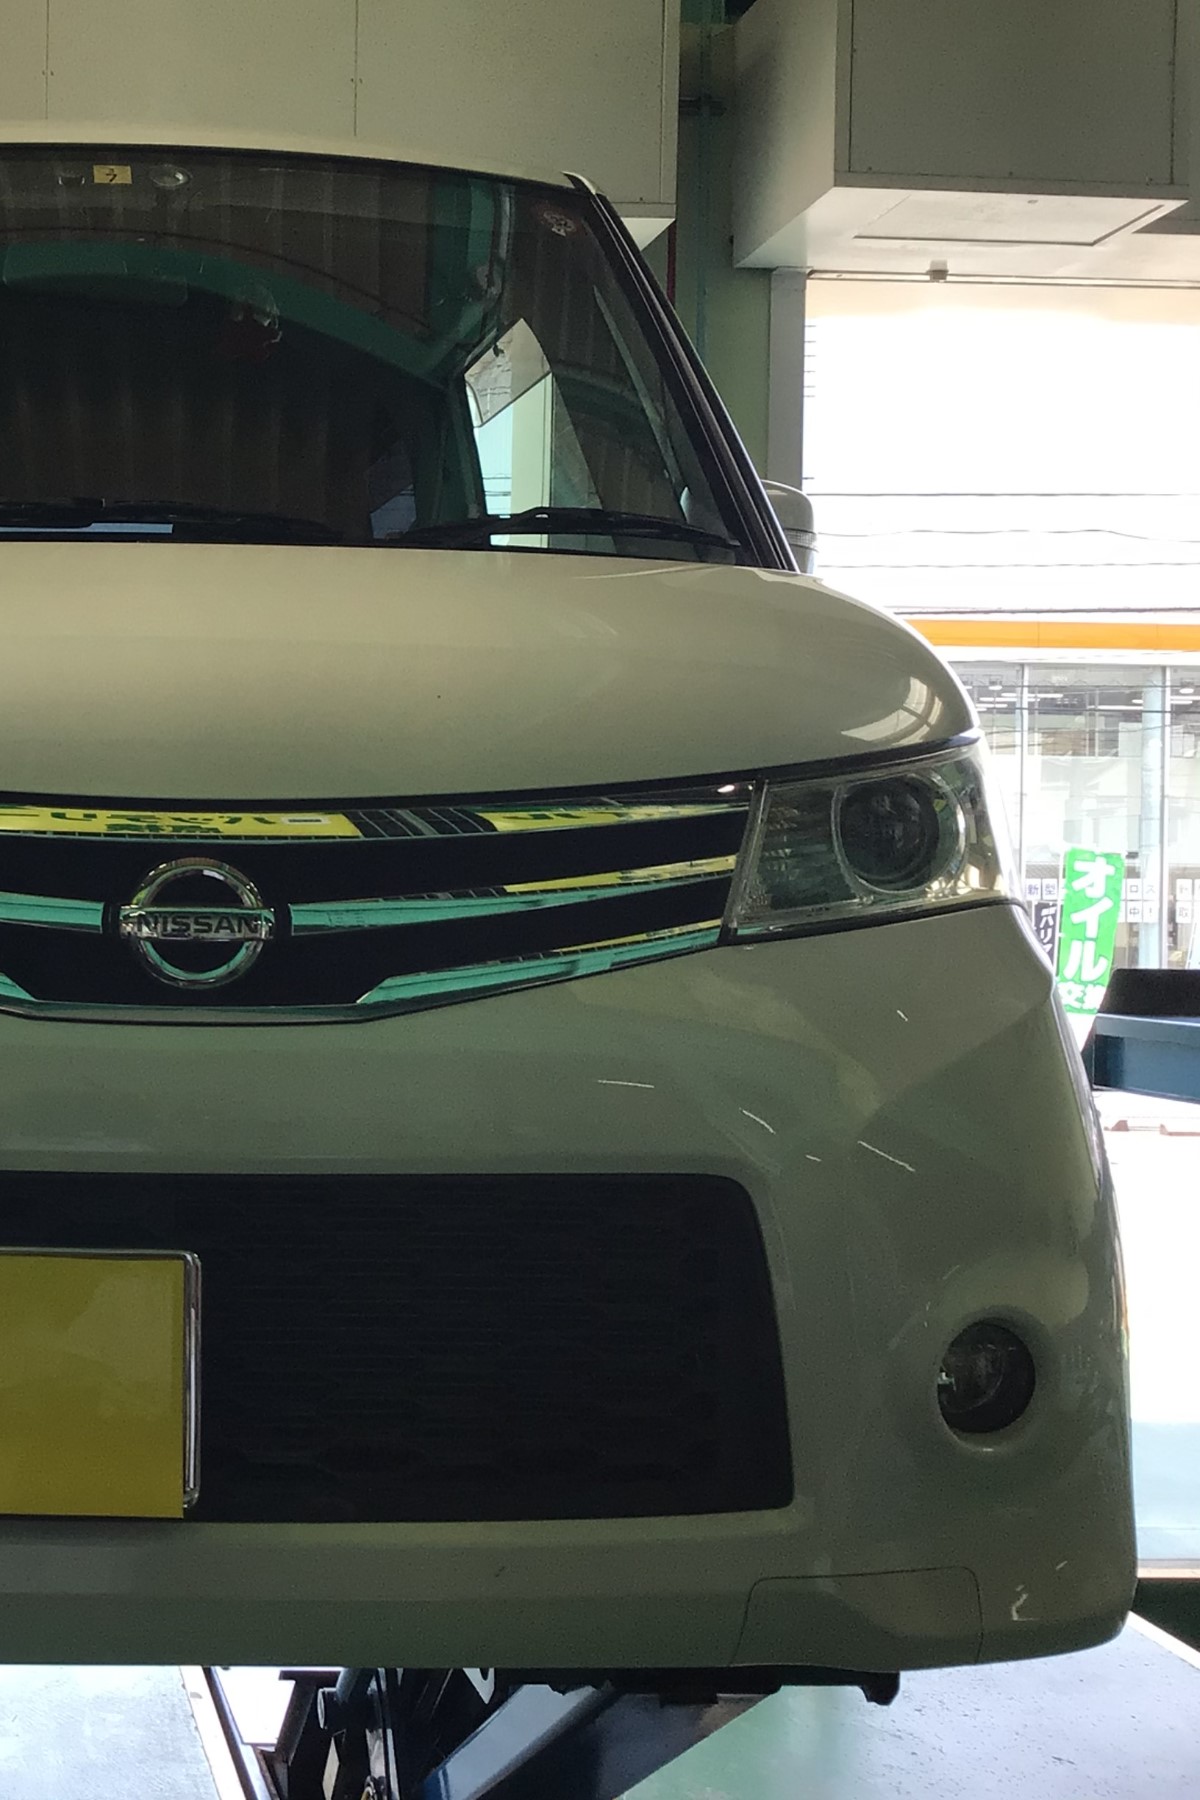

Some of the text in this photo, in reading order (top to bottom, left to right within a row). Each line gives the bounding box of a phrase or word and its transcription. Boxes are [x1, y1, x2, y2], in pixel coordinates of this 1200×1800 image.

[137, 914, 260, 934] NISSAN
[1063, 855, 1116, 982] オイル
